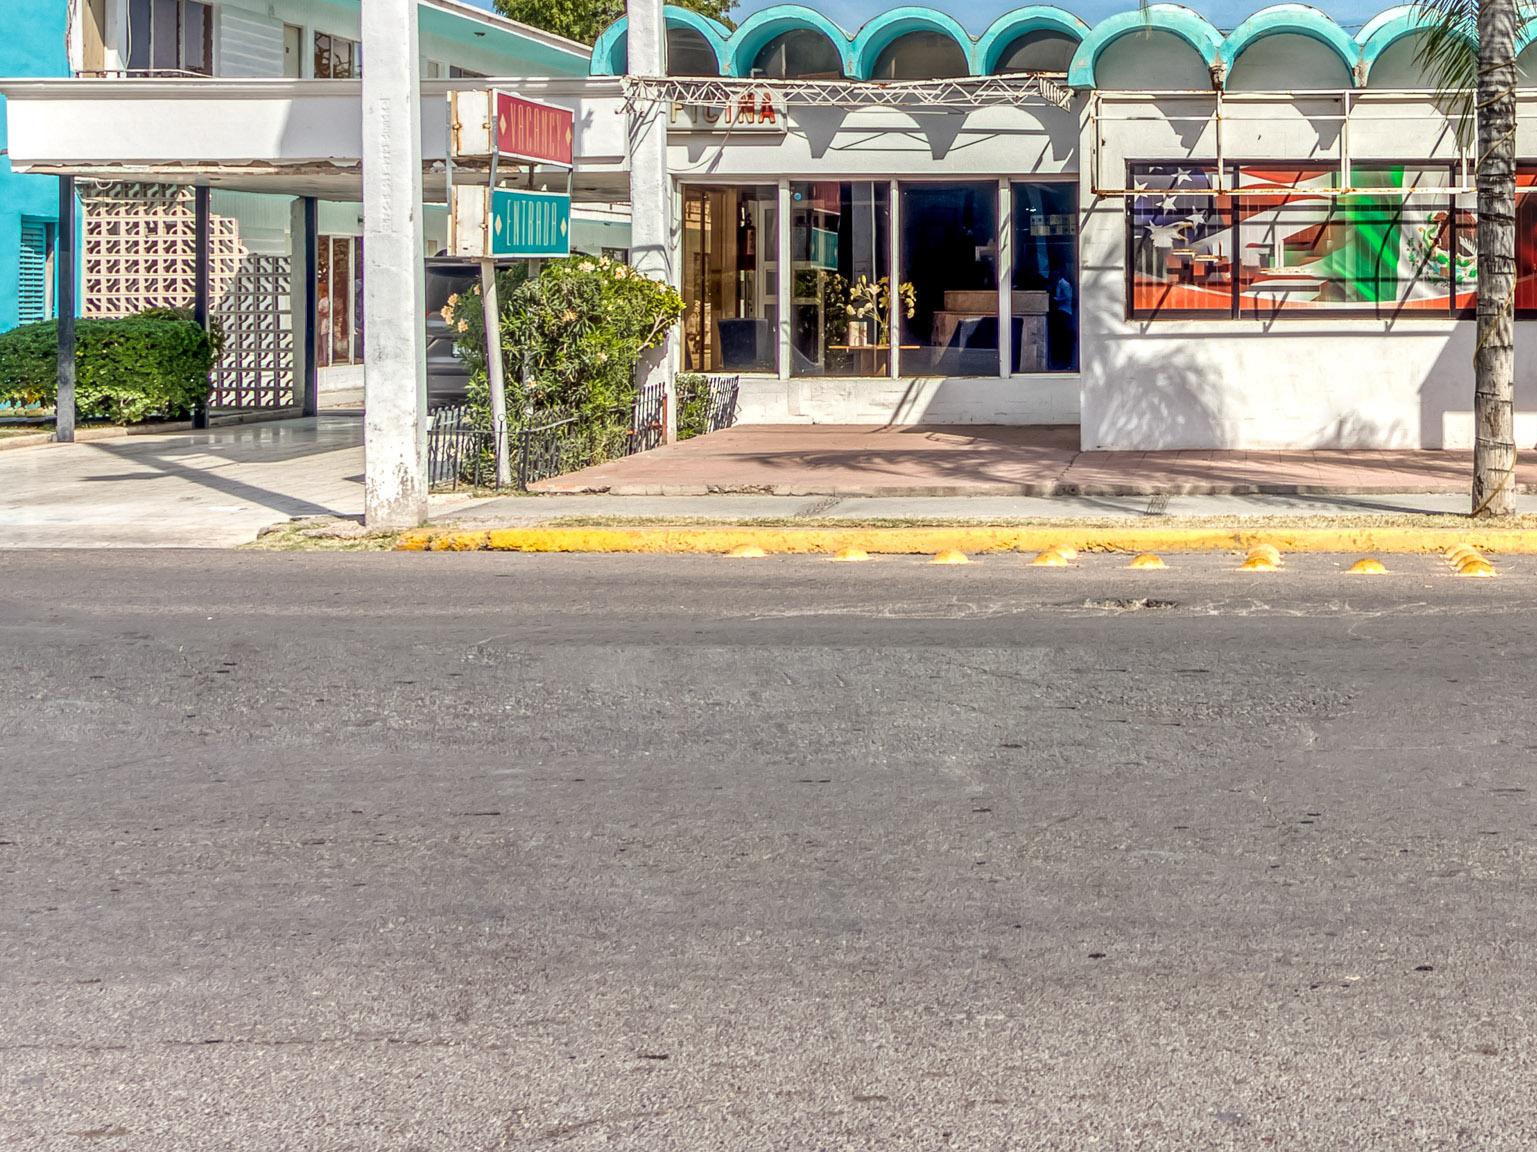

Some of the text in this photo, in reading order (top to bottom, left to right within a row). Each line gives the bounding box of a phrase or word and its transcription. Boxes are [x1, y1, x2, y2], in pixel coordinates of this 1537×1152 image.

[510, 102, 563, 159] VACANCY
[670, 92, 777, 124] FICINA
[506, 199, 558, 247] ENTRADA
